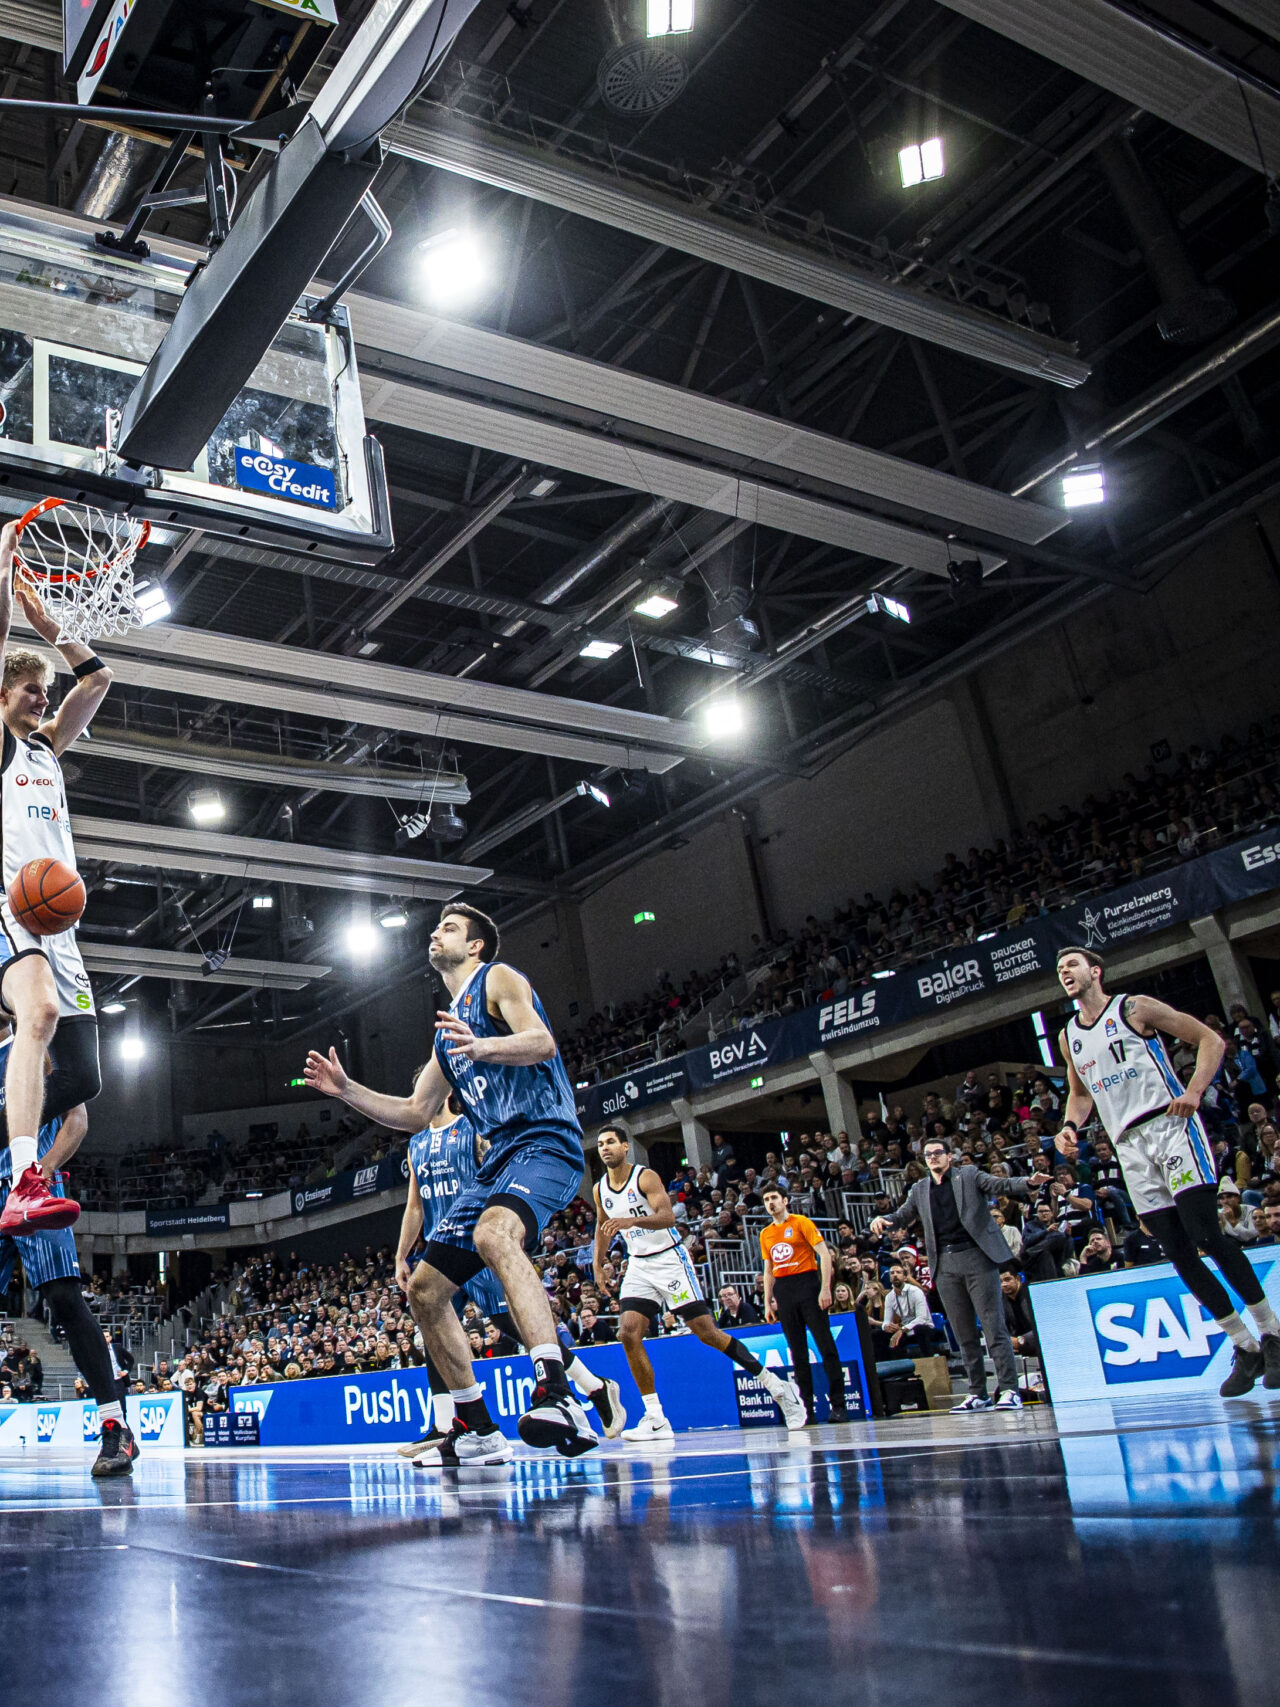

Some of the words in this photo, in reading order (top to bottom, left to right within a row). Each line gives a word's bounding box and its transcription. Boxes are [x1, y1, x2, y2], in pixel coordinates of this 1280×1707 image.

[268, 474, 330, 503] Credit
[1103, 886, 1172, 918] Purzelzwerg
[1107, 901, 1172, 931] Kleinkindbetreuung
[1109, 912, 1171, 939] Waldkindergarten
[935, 980, 985, 1005] DigitalDruck
[819, 990, 876, 1031] FELS
[821, 1015, 880, 1043] #wirsindumzug
[709, 1040, 745, 1069] BGV
[1108, 1039, 1128, 1065] 17
[1091, 1067, 1138, 1095] experia
[304, 1186, 333, 1201] Ensinger
[149, 1218, 186, 1228] Sportstadt
[187, 1215, 226, 1224] Heidelberg
[1095, 1293, 1225, 1366] SAP
[736, 1376, 767, 1391] Mein
[343, 1378, 411, 1425] Push
[739, 1393, 763, 1407] Bank
[763, 1392, 773, 1405] in
[37, 1413, 56, 1437] SAP
[83, 1411, 100, 1436] SA
[141, 1407, 166, 1435] SAP
[741, 1408, 775, 1419] Heidelberg
